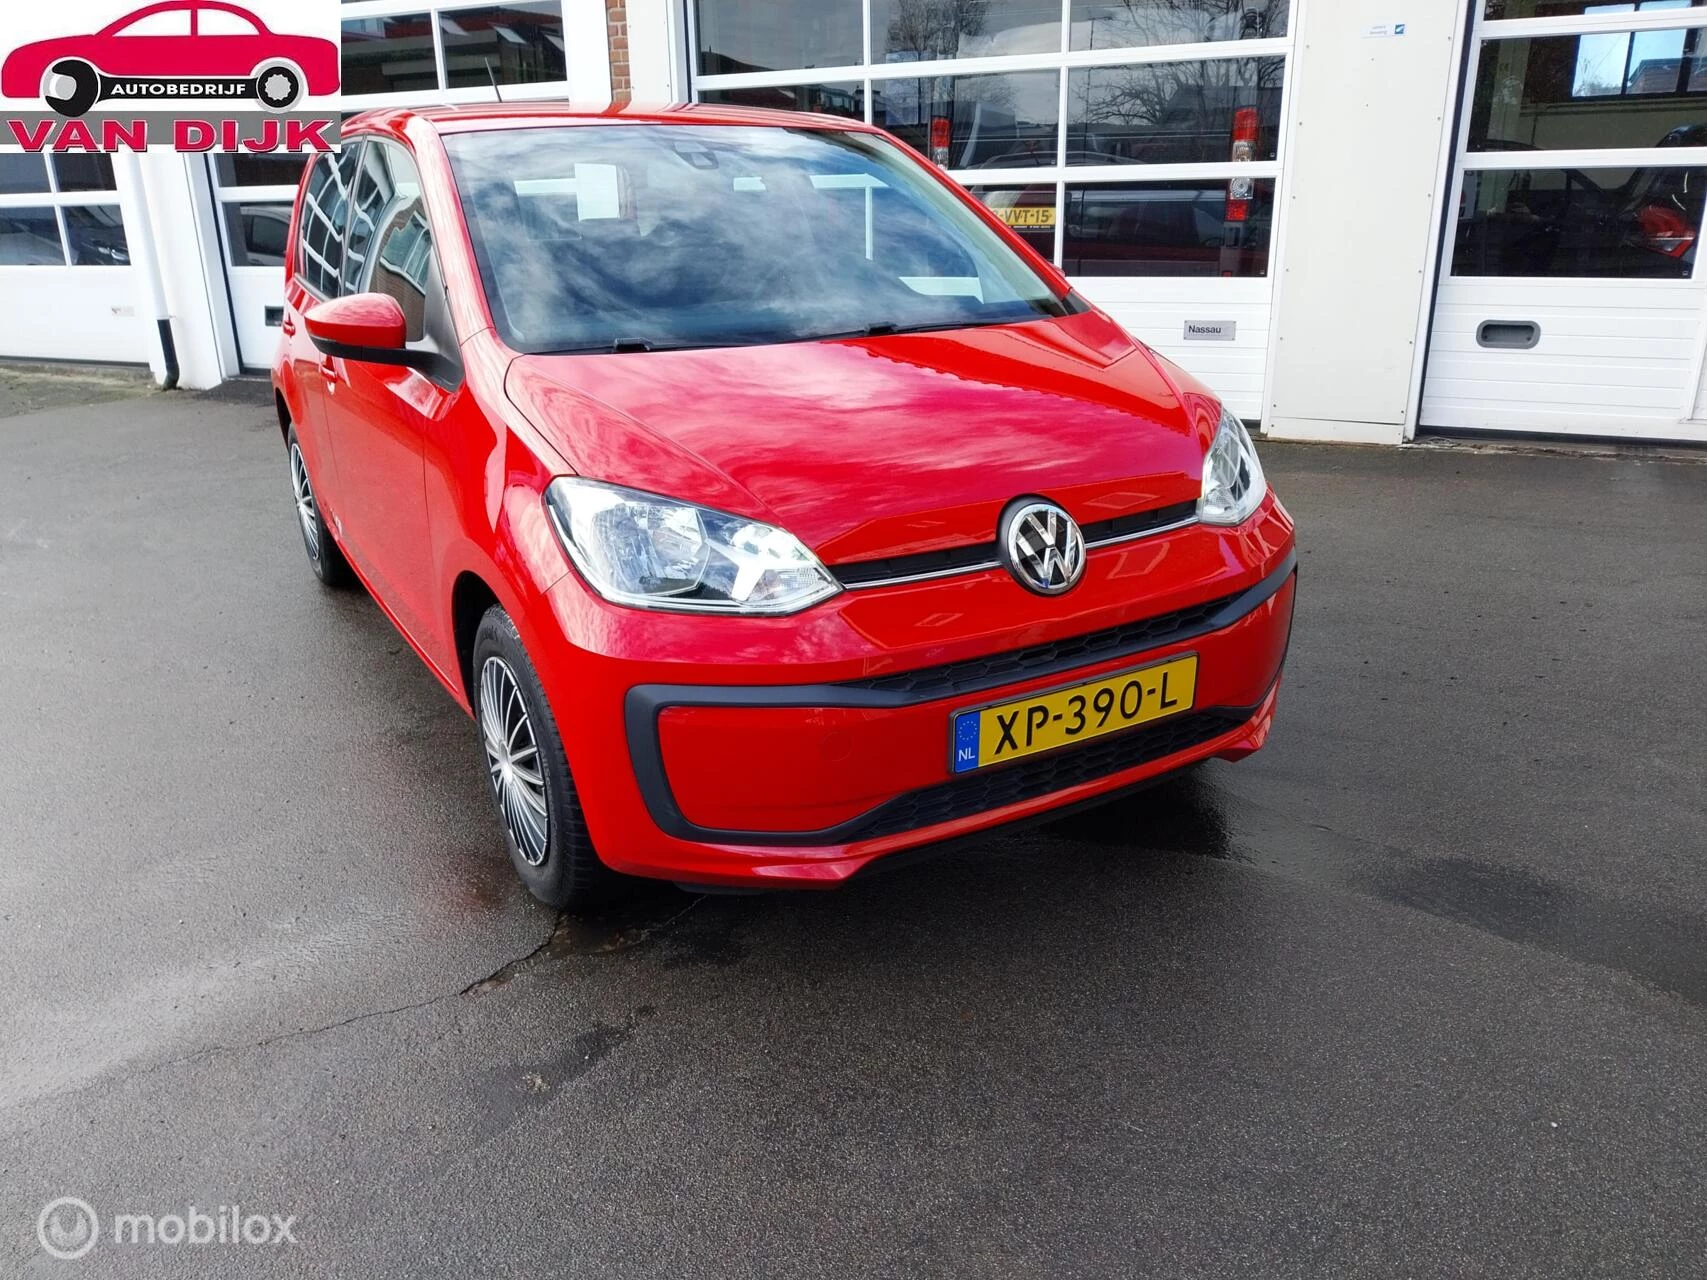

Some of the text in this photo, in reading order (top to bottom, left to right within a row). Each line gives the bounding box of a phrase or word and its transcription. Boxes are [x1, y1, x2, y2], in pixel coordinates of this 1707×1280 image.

[1188, 324, 1222, 334] Nassau
[994, 671, 1178, 755] XP-390-L
[958, 747, 976, 762] NL
